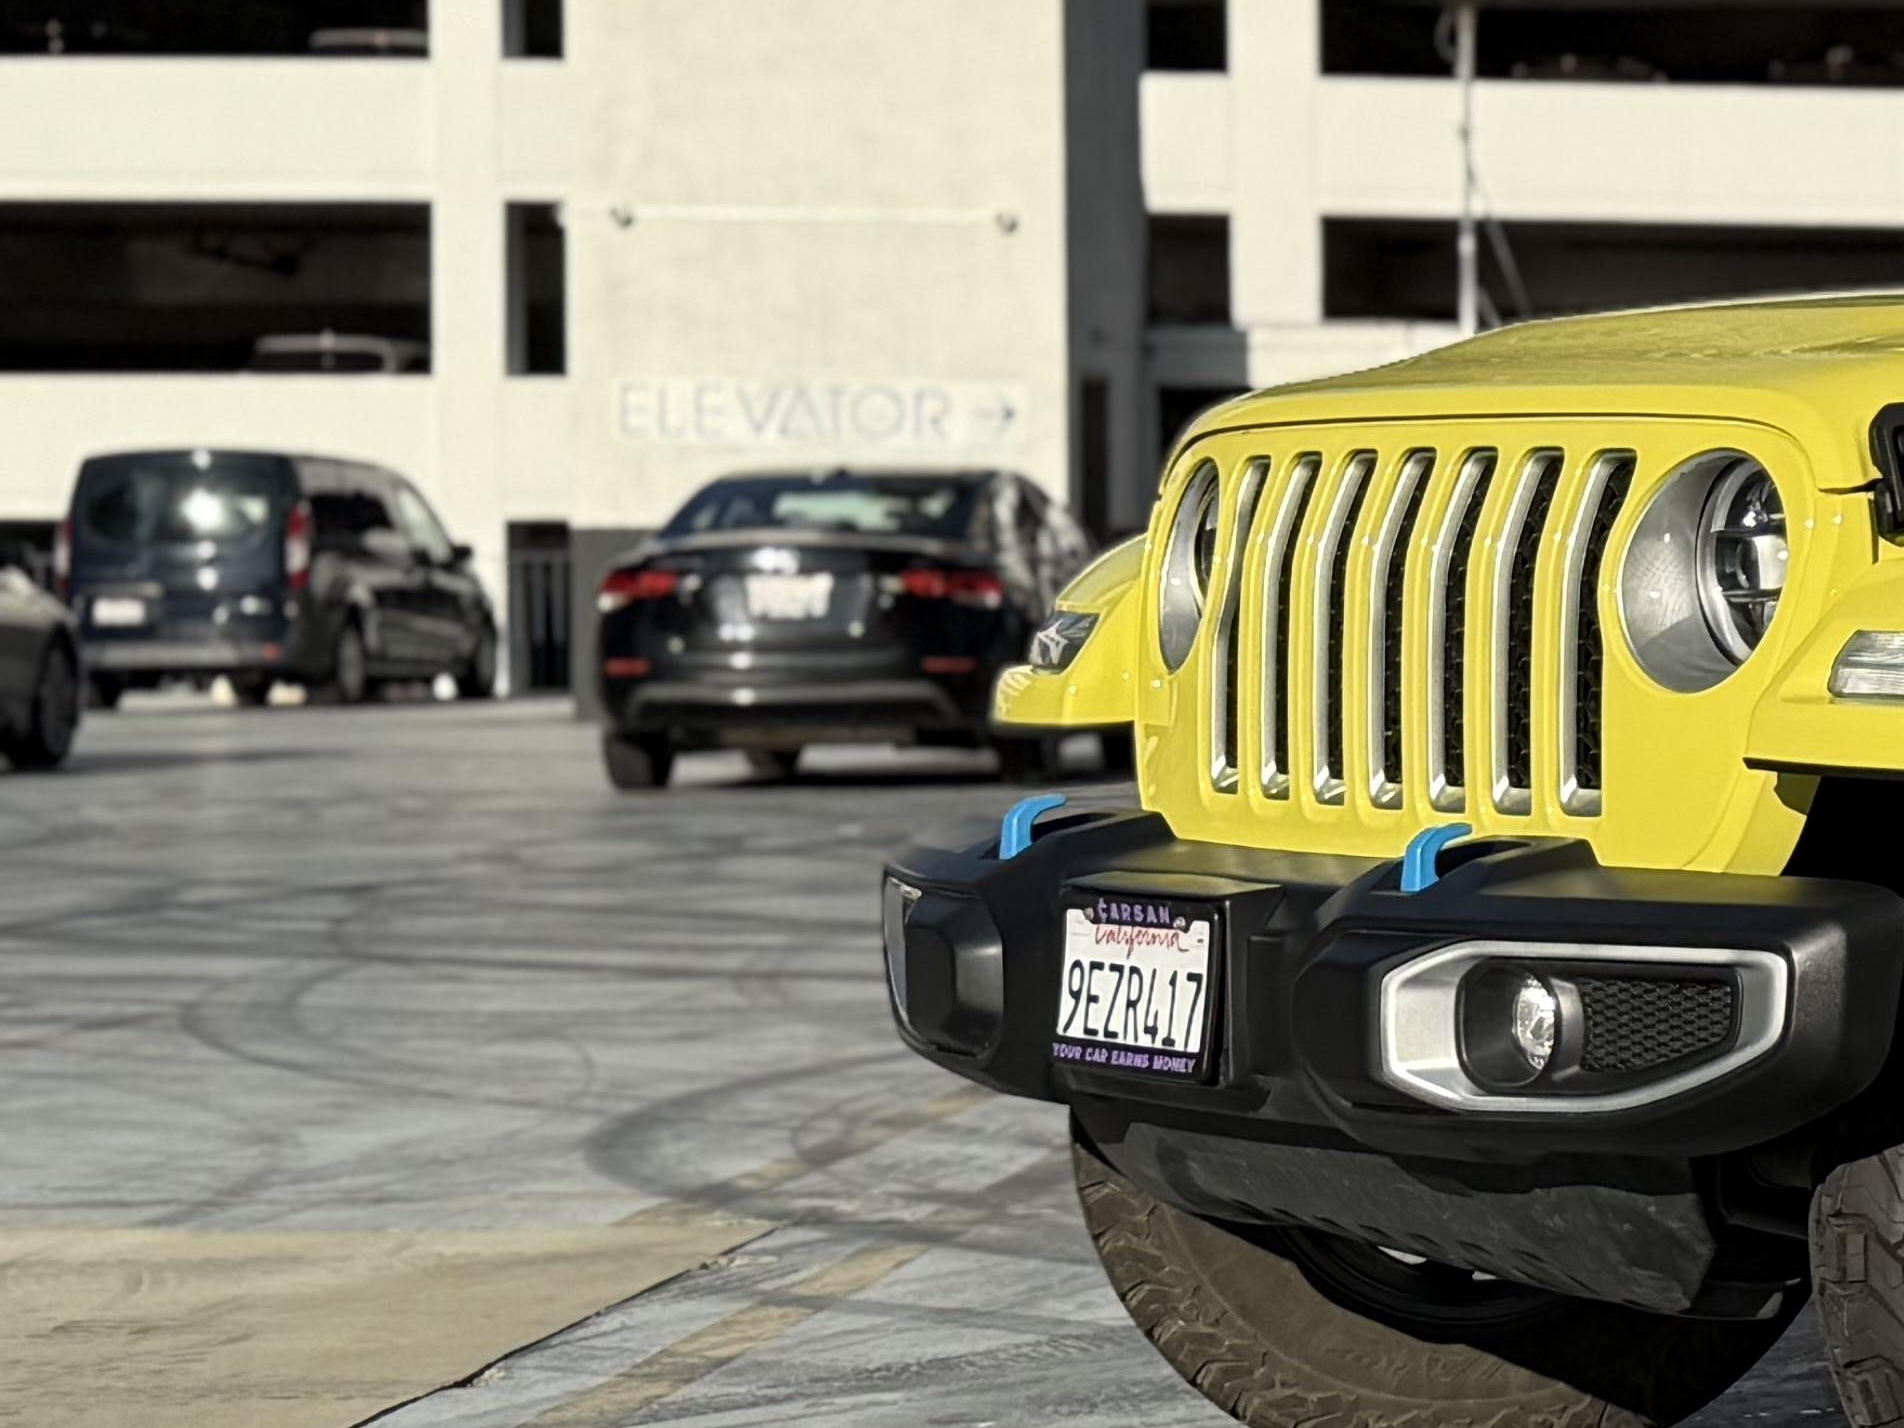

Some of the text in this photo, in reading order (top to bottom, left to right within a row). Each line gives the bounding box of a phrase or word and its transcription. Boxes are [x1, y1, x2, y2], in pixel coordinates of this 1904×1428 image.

[618, 381, 952, 439] ELEVATOR
[1095, 924, 1190, 959] California
[1062, 959, 1204, 1052] 9EZR417
[1052, 1042, 1196, 1073] YOUR CAR EARNS MONEY
